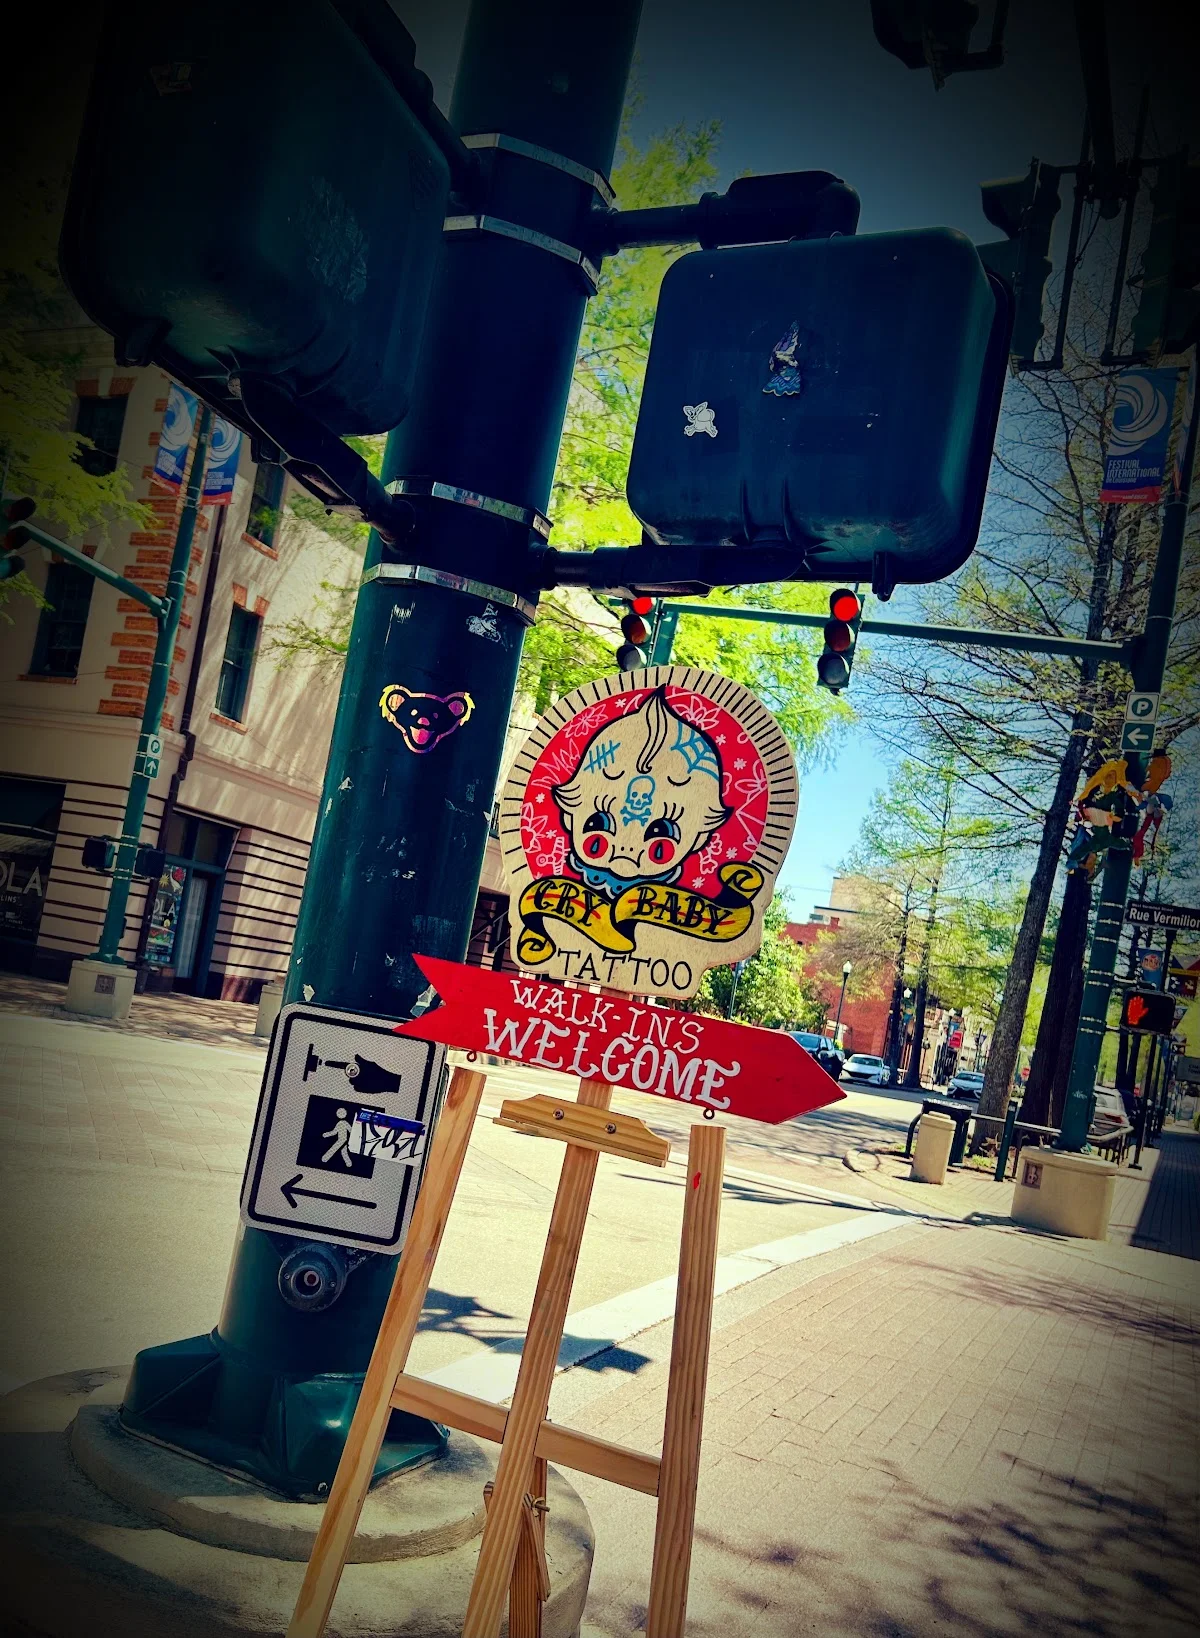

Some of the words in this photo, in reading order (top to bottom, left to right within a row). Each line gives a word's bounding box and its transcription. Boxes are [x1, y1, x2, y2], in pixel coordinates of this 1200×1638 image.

[1106, 467, 1161, 479] INTERNATIONAL
[1108, 459, 1140, 470] FESTIVAL
[1136, 701, 1149, 714] P
[0, 860, 43, 897] LA
[533, 880, 611, 927] CRY
[631, 886, 734, 936] BABY
[1129, 907, 1150, 922] Rue
[557, 948, 693, 991] TATTOO
[510, 980, 704, 1054] WALK-IN'S
[483, 1008, 741, 1110] WELCOME
